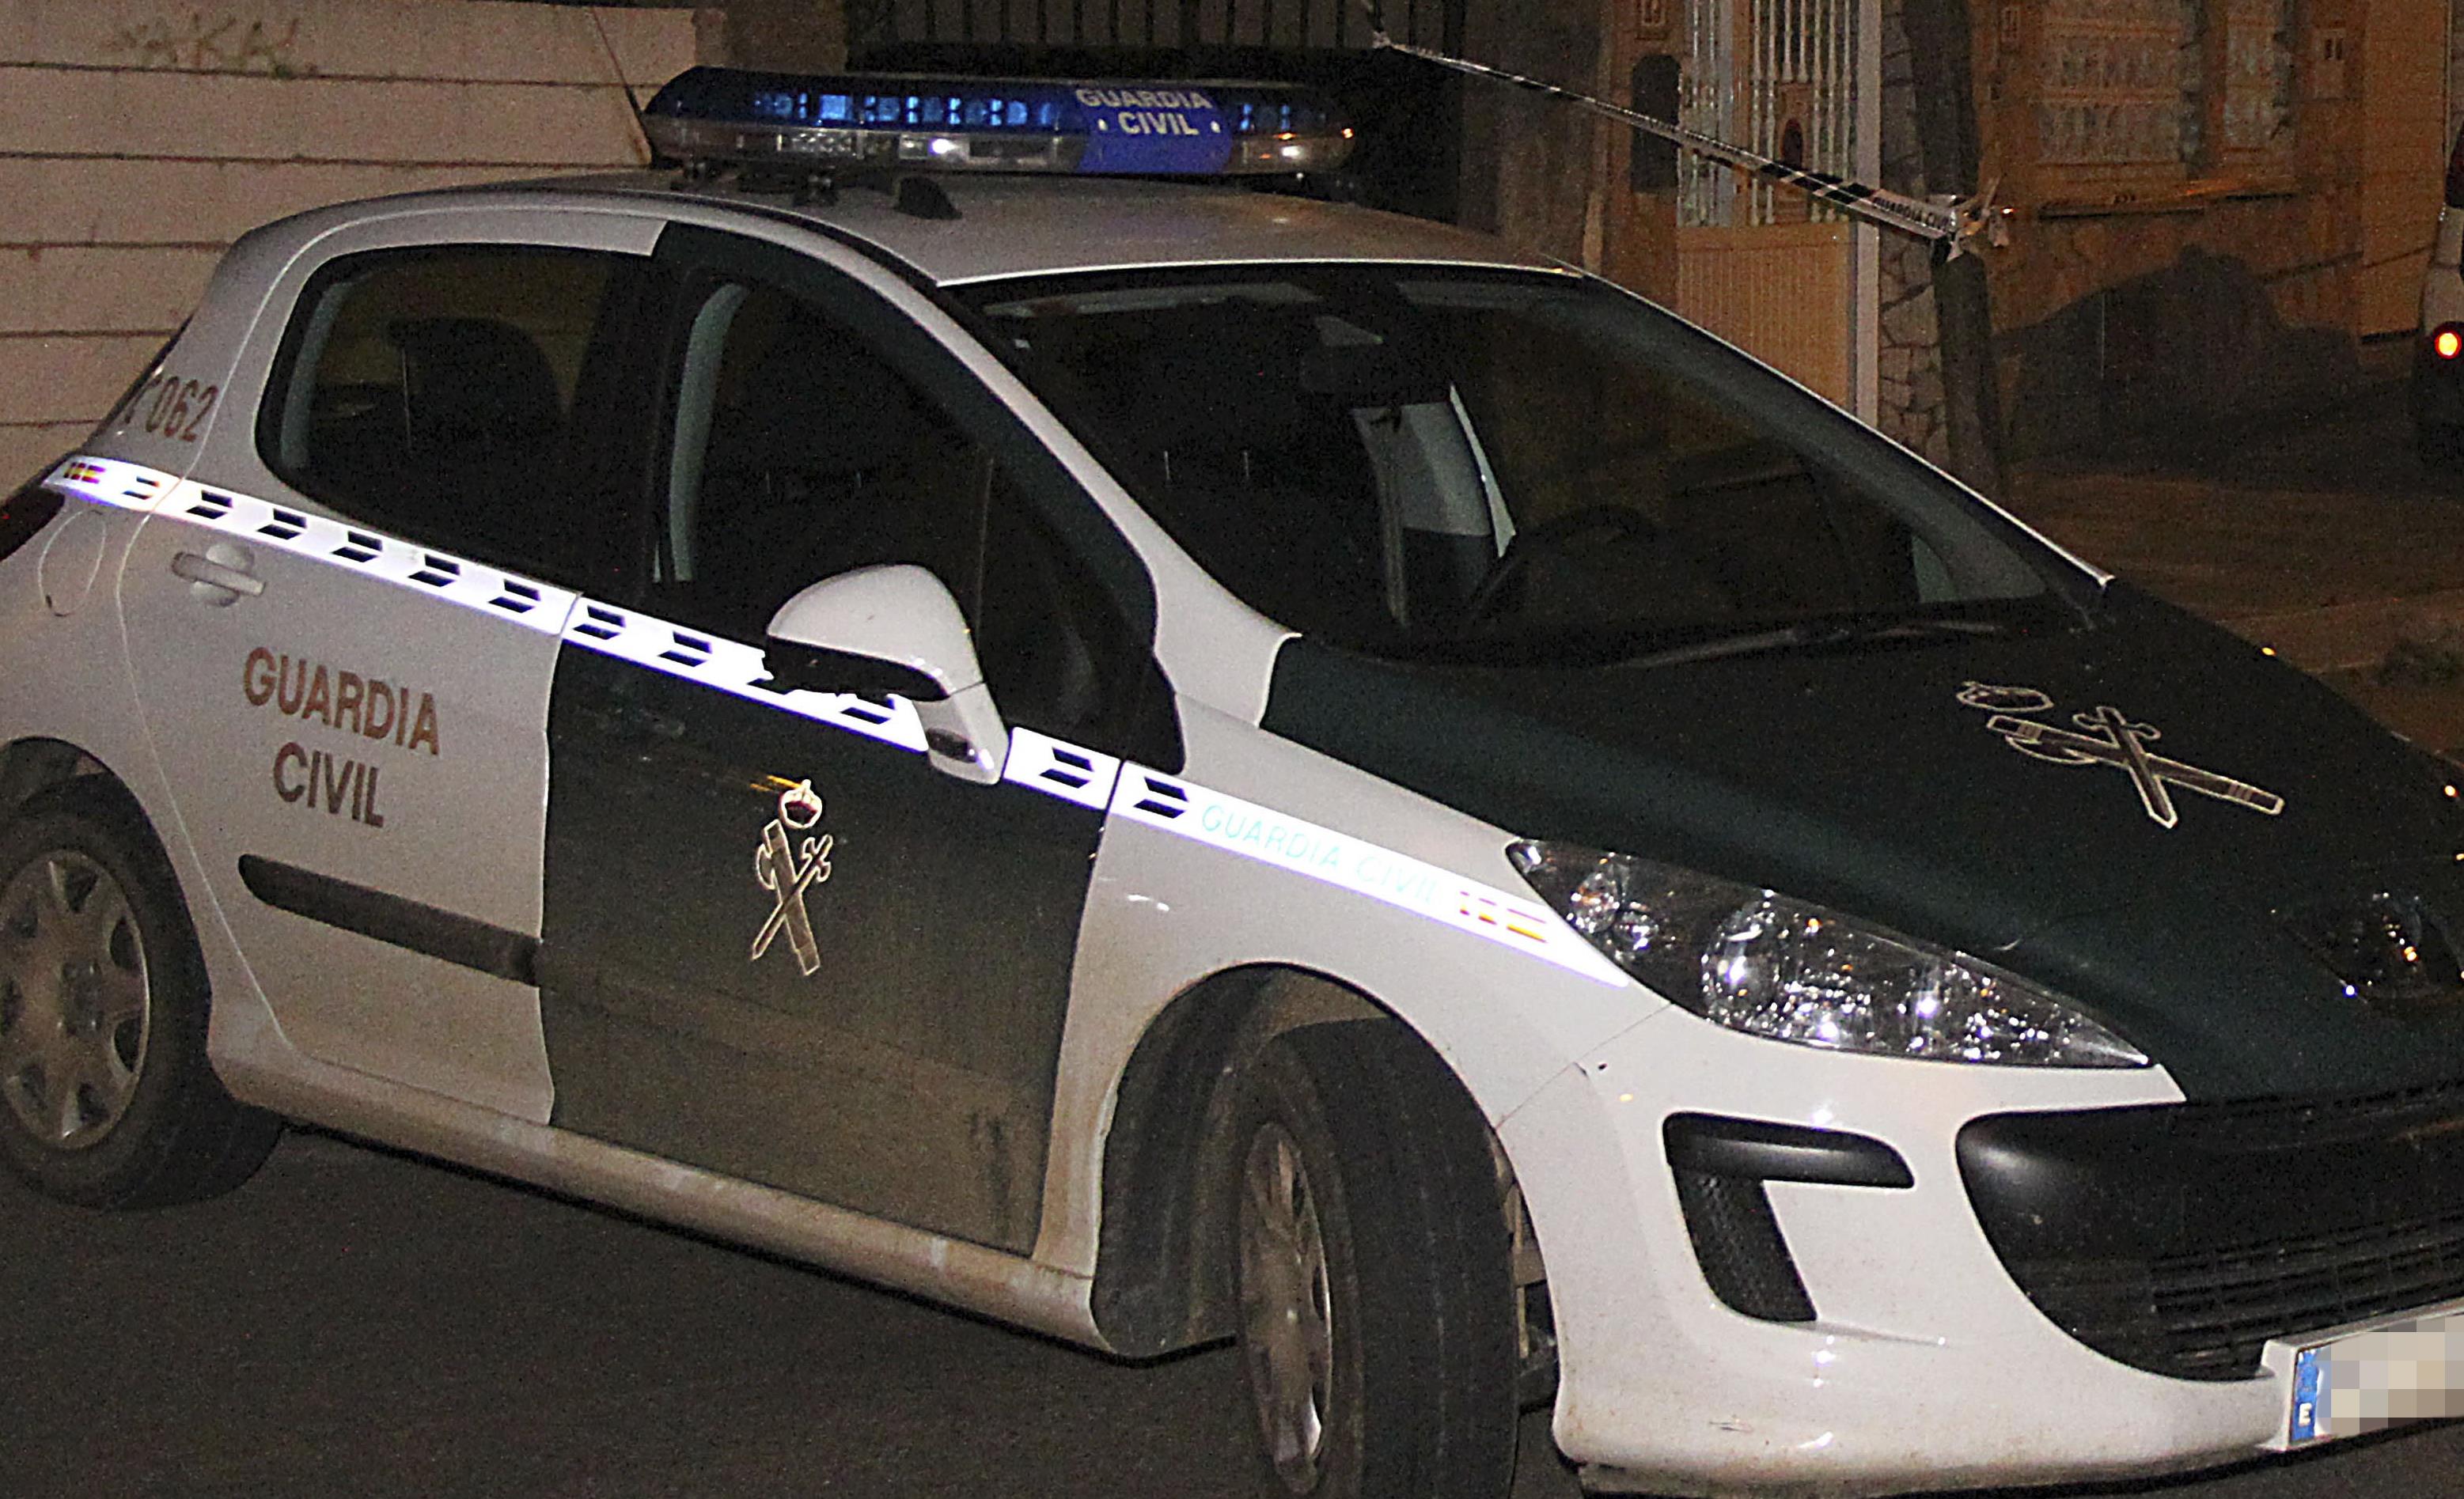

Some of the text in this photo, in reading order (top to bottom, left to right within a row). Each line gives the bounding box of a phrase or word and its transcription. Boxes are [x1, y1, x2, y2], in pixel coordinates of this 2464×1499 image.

[1076, 89, 1213, 108] GUARDIA
[1118, 112, 1200, 135] CIVIL
[243, 646, 440, 755] GUARDIA
[273, 741, 385, 827] CIVIL
[1200, 803, 1341, 868] GUARDIA
[2299, 1402, 2312, 1425] E
